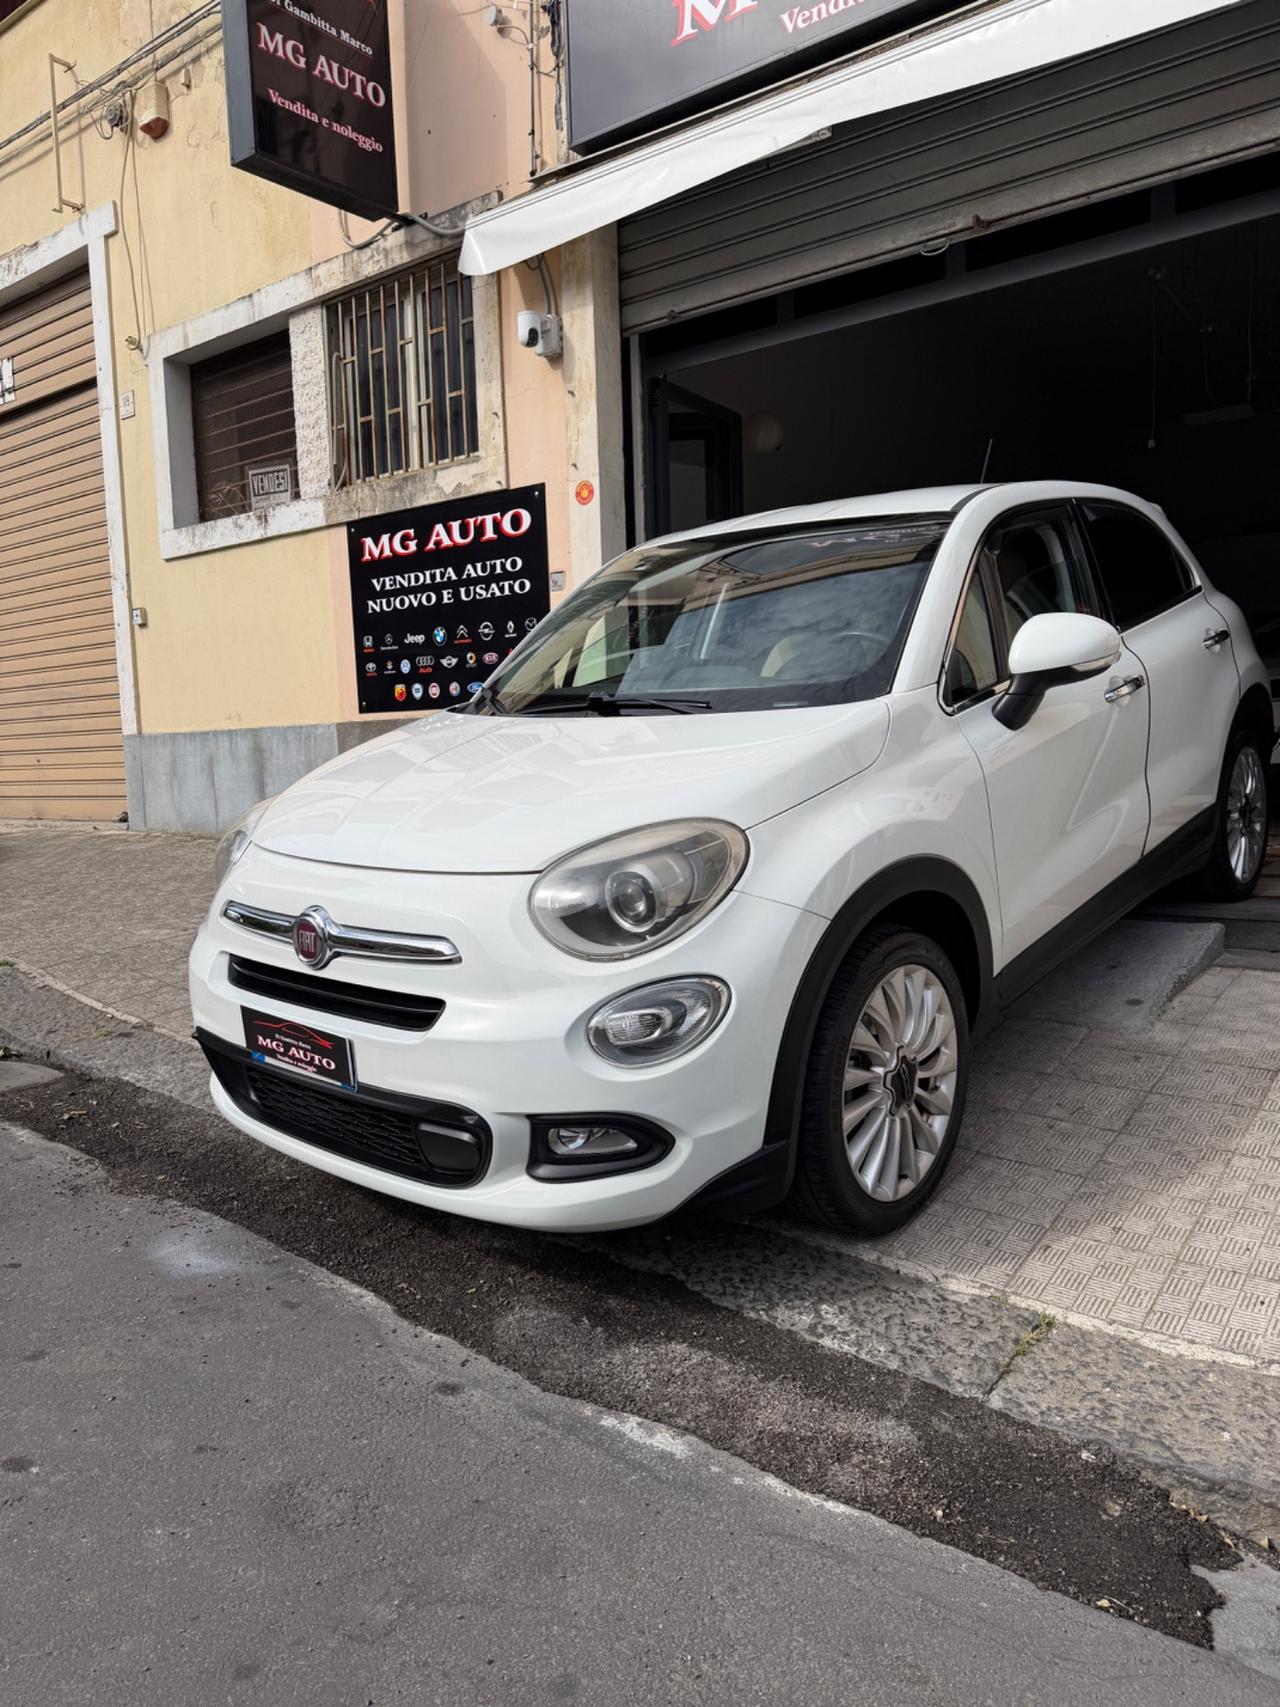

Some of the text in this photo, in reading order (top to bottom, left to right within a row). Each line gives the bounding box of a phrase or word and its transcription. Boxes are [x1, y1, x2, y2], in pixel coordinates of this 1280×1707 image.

[284, 0, 374, 56] Gambitta Marco
[256, 22, 387, 108] MG AUTO
[267, 88, 384, 153] Vendita e noleggio
[252, 470, 288, 496] VENDESI
[360, 508, 532, 562] MG AUTO
[371, 556, 523, 592] VENDITA AUTO
[367, 578, 531, 614] NUOVO E USATO
[404, 633, 425, 645] Jeep
[299, 930, 316, 952] FIAT
[257, 1034, 285, 1053] MG
[288, 1046, 336, 1071] AUTO
